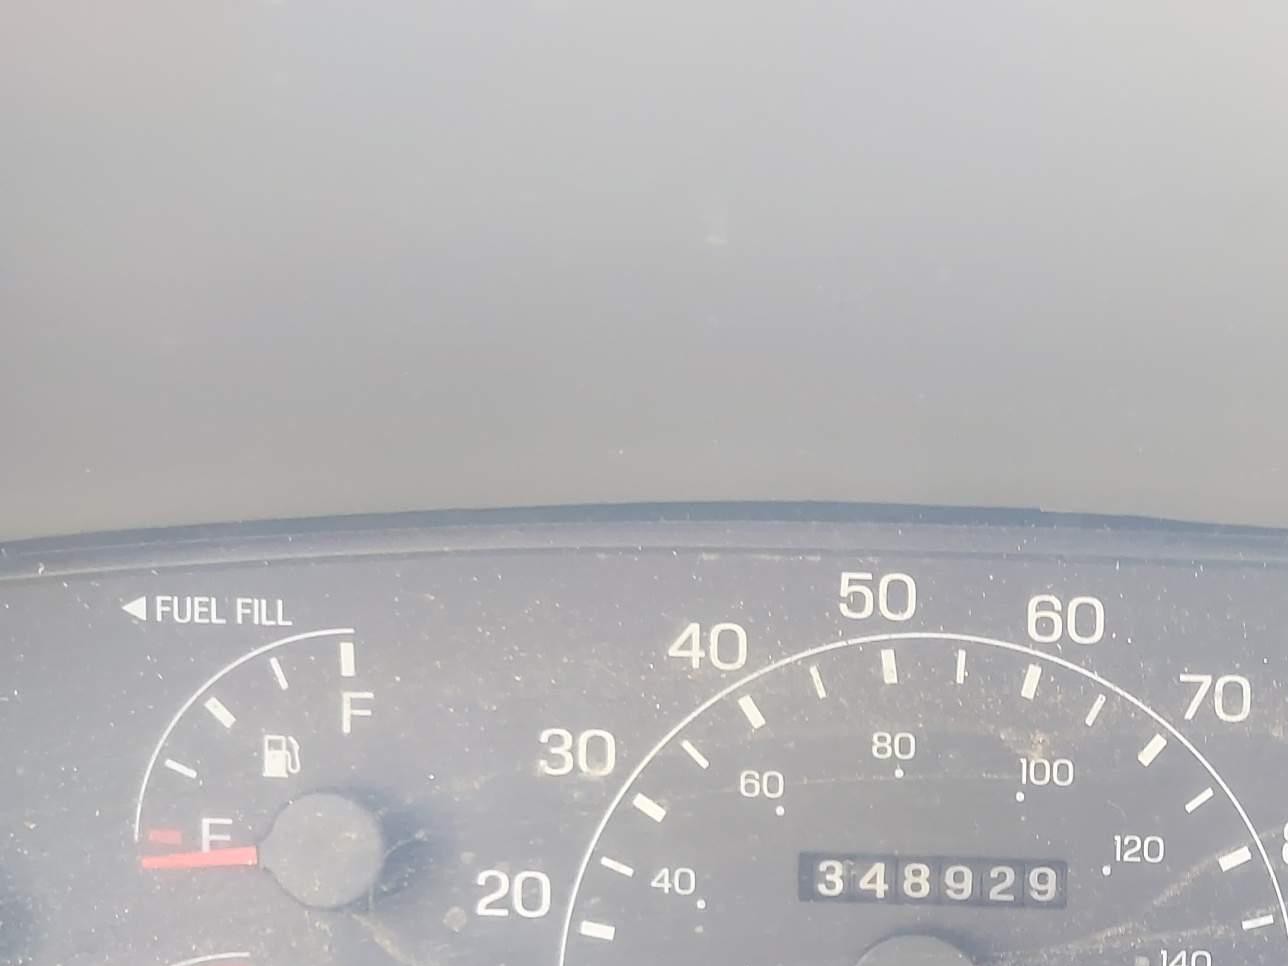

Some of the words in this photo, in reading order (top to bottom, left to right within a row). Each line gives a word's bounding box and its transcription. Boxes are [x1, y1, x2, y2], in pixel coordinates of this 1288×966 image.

[156, 596, 226, 624] FUEL
[237, 599, 292, 626] FILL
[839, 572, 917, 621] 50
[1027, 595, 1105, 644] 60
[668, 623, 748, 670] 40
[342, 691, 374, 733] F
[1180, 674, 1251, 722] 70
[538, 729, 616, 776] 30
[871, 732, 916, 759] 80
[739, 771, 785, 798] 60
[1019, 759, 1074, 786] 100
[1113, 836, 1165, 863] 120
[475, 870, 551, 917] 20
[651, 868, 696, 895] 40
[817, 859, 1057, 901] 348929
